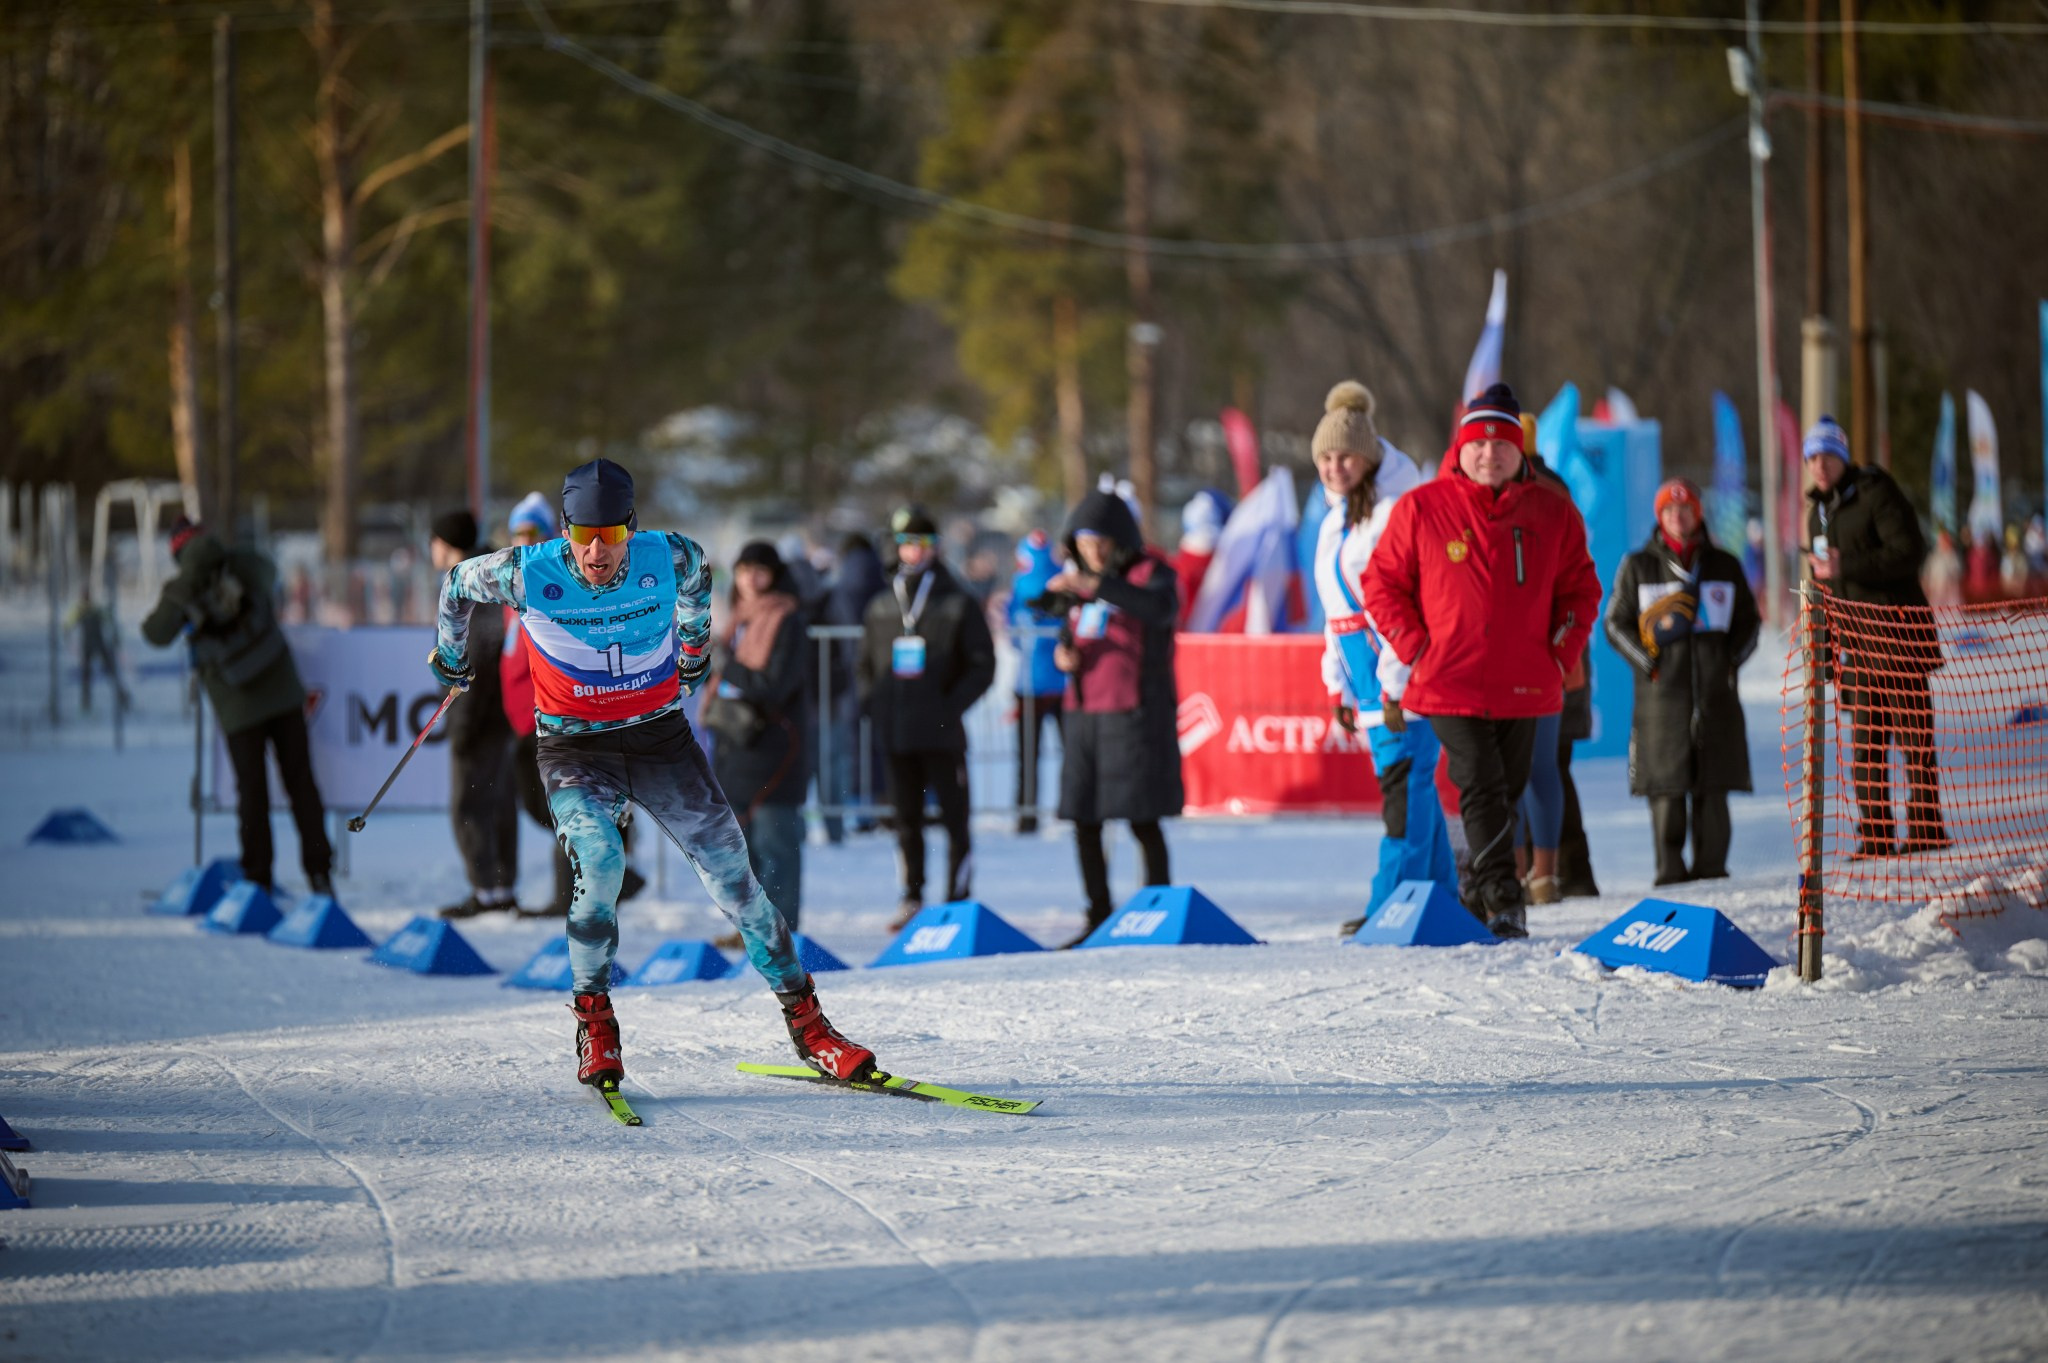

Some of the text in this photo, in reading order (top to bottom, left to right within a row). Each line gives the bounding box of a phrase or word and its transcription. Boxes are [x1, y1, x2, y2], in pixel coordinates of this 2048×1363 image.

[550, 595, 657, 615] СВЕРДЛОВСКАЯ ОБЛАСТЬ
[550, 603, 661, 626] ЛЫЖНЯ РОССИИ
[597, 642, 624, 678] 1
[962, 1096, 1022, 1110] FISCHER
